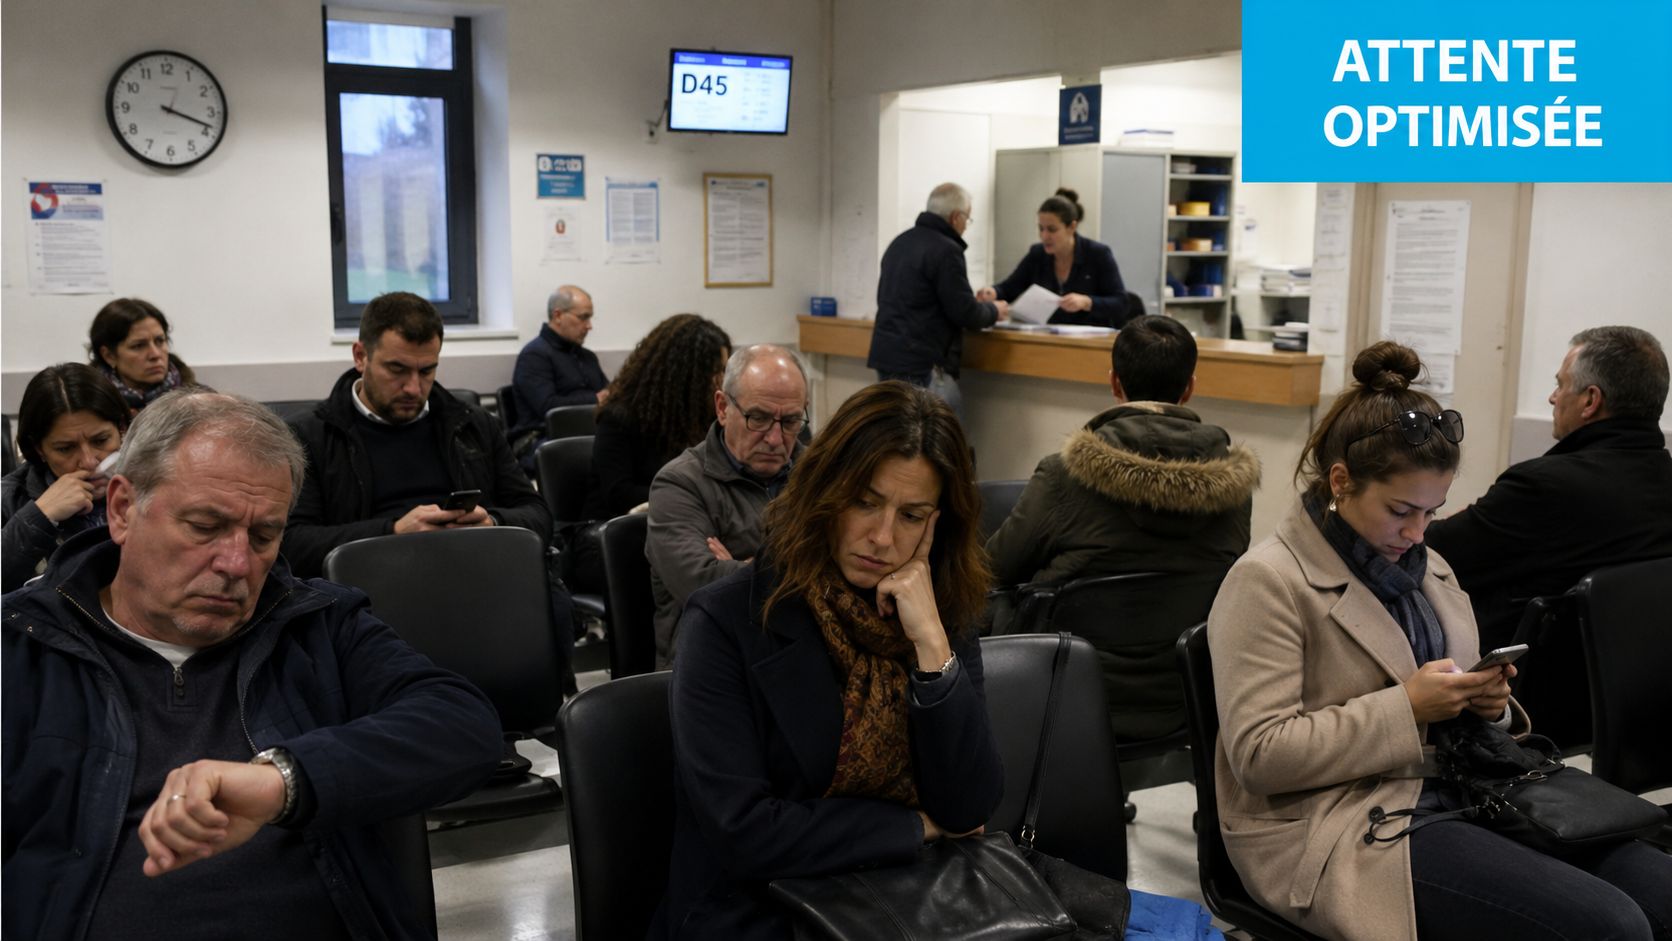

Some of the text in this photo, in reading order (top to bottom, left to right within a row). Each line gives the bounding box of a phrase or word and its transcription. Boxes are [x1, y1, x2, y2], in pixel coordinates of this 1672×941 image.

[141, 68, 152, 80] 11
[160, 63, 174, 76] 12
[185, 70, 191, 82] 1
[127, 82, 140, 94] 10
[681, 73, 728, 96] D45
[200, 85, 209, 98] 2
[121, 102, 131, 114] 9
[207, 106, 216, 119] 3
[129, 123, 138, 135] 8
[201, 126, 209, 137] 4
[146, 139, 154, 150] 7
[187, 140, 196, 152] 5
[166, 146, 176, 157] 6
